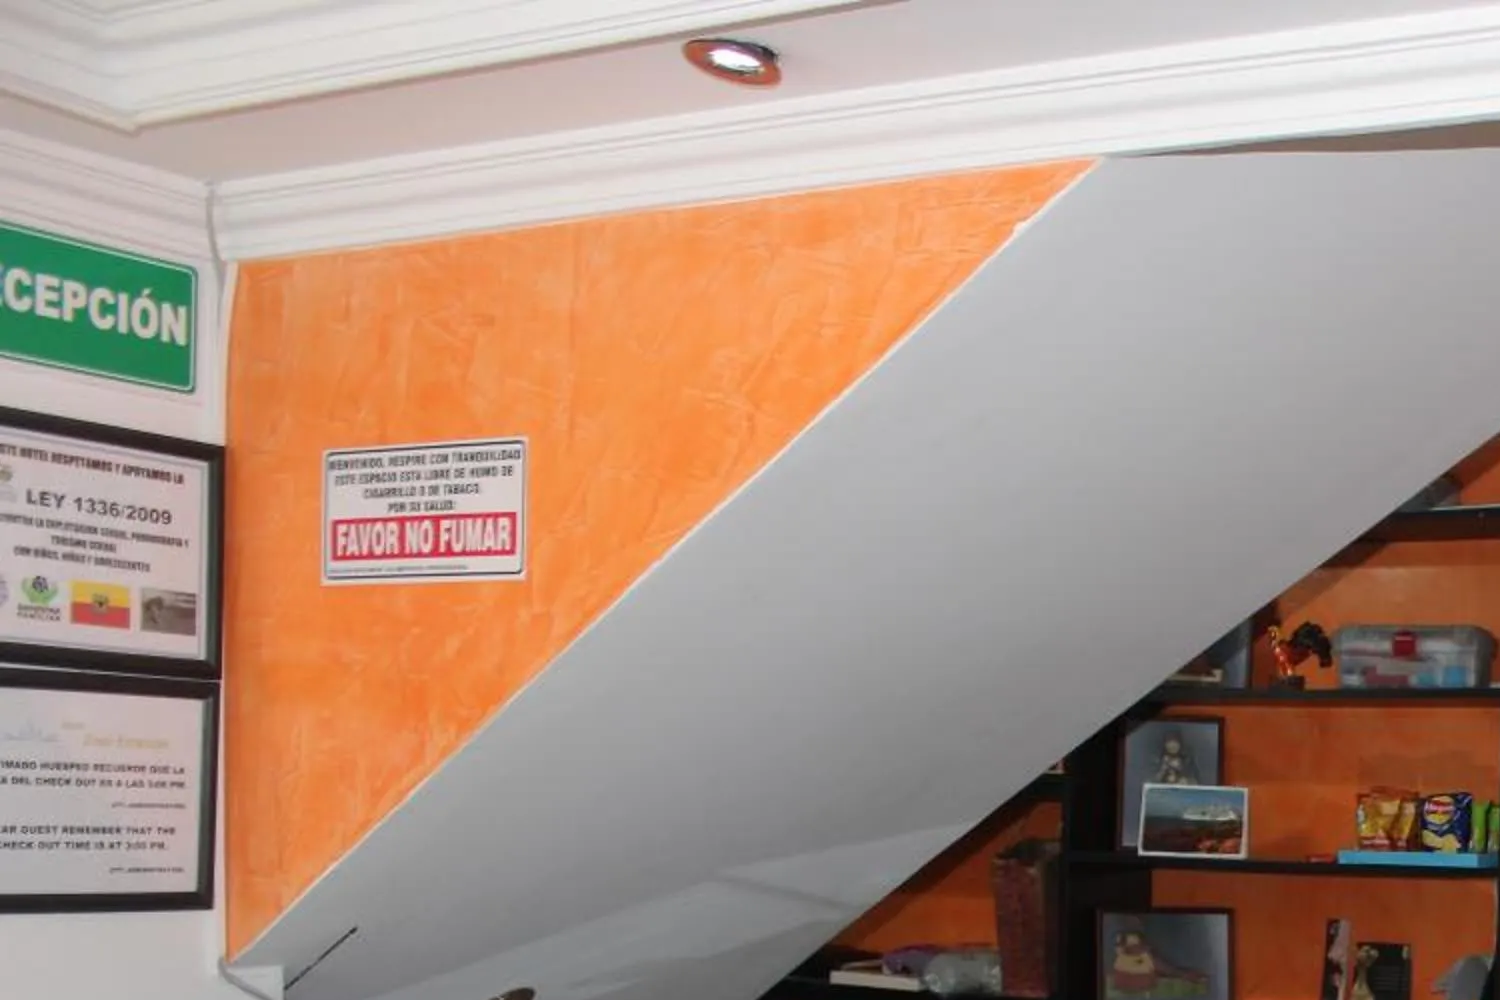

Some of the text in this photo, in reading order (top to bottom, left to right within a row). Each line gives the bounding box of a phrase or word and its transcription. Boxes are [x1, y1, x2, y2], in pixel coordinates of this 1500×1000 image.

[0, 264, 188, 347] CEPCIÓN
[387, 454, 426, 467] RESPIRE
[430, 453, 449, 464] CON
[451, 449, 522, 462] TRANQUILIDAD
[51, 452, 113, 472] RESPETAMOS
[122, 464, 171, 483] APOYAMOS
[423, 469, 450, 480] LIBRE
[453, 467, 466, 478] DE
[501, 465, 513, 476] DE
[363, 486, 417, 498] CIGARRILLO
[427, 485, 440, 496] DE
[26, 488, 172, 525] LEY 1336/2009
[387, 502, 406, 513] POR
[336, 514, 512, 557] FAVOR NO FUMAR
[0, 760, 37, 770] IMADO
[149, 764, 170, 776] QUE
[173, 767, 185, 776] LA
[36, 777, 71, 788] CHECK
[75, 778, 97, 788] OUT
[125, 779, 146, 790] LAS
[20, 825, 59, 836] GUEST
[62, 825, 123, 836] REMEMBER
[126, 826, 152, 836] THAT
[157, 825, 176, 836] THE
[38, 841, 60, 851] OUT
[63, 841, 91, 852] TIME
[94, 841, 105, 851] IS
[109, 841, 121, 851] AT
